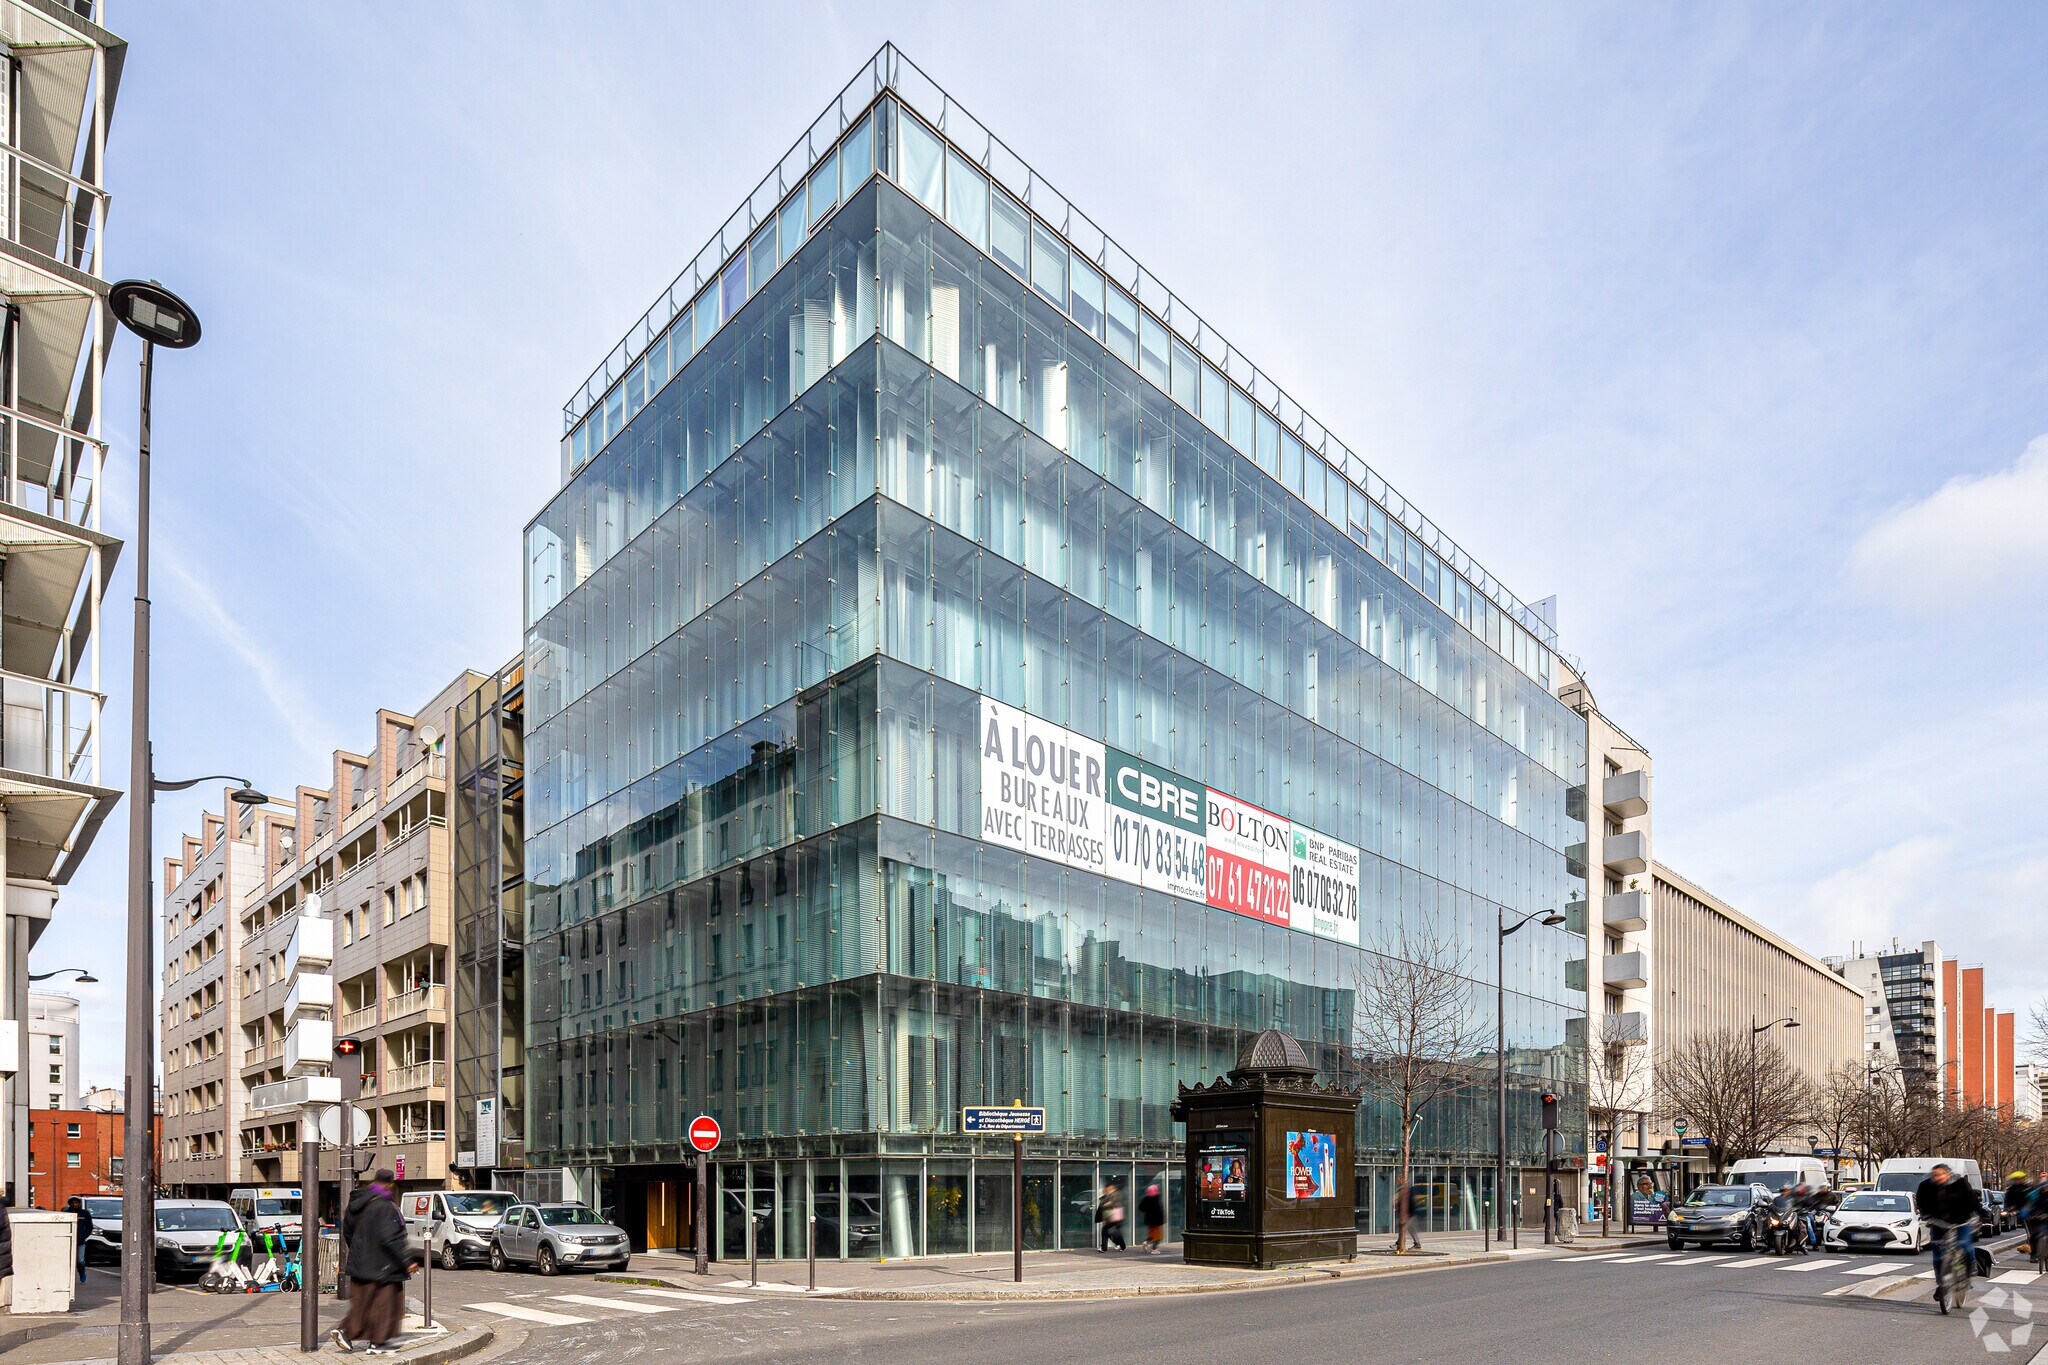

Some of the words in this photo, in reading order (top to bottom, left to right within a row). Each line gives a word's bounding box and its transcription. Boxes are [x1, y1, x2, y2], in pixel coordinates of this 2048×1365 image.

[984, 705, 1004, 763] À
[1012, 726, 1101, 798] LOUER
[1001, 771, 1089, 830] BUREAUX
[1117, 766, 1199, 824] CBRE
[984, 806, 1022, 841] AVEC
[1031, 820, 1104, 866] TERRASSES
[1114, 814, 1128, 864] 01
[1132, 820, 1151, 870] 70
[1156, 828, 1172, 877] 83
[1175, 835, 1189, 881] 54
[1191, 841, 1205, 886] 48
[1208, 801, 1288, 853] BOLTON
[1309, 839, 1325, 852] BNP
[1328, 845, 1358, 865] PARIBAS
[1167, 880, 1205, 899] immo.cbre.fr
[1208, 854, 1224, 900] 07
[1228, 861, 1242, 906] 61
[1246, 868, 1262, 911] 47
[1263, 873, 1275, 916] 21
[1277, 878, 1289, 920] 22
[1309, 851, 1328, 867] REAL
[1329, 858, 1354, 876] ESTATE
[1293, 865, 1305, 905] 06
[1346, 883, 1357, 921] 78
[1290, 1167, 1313, 1176] FLOWER
